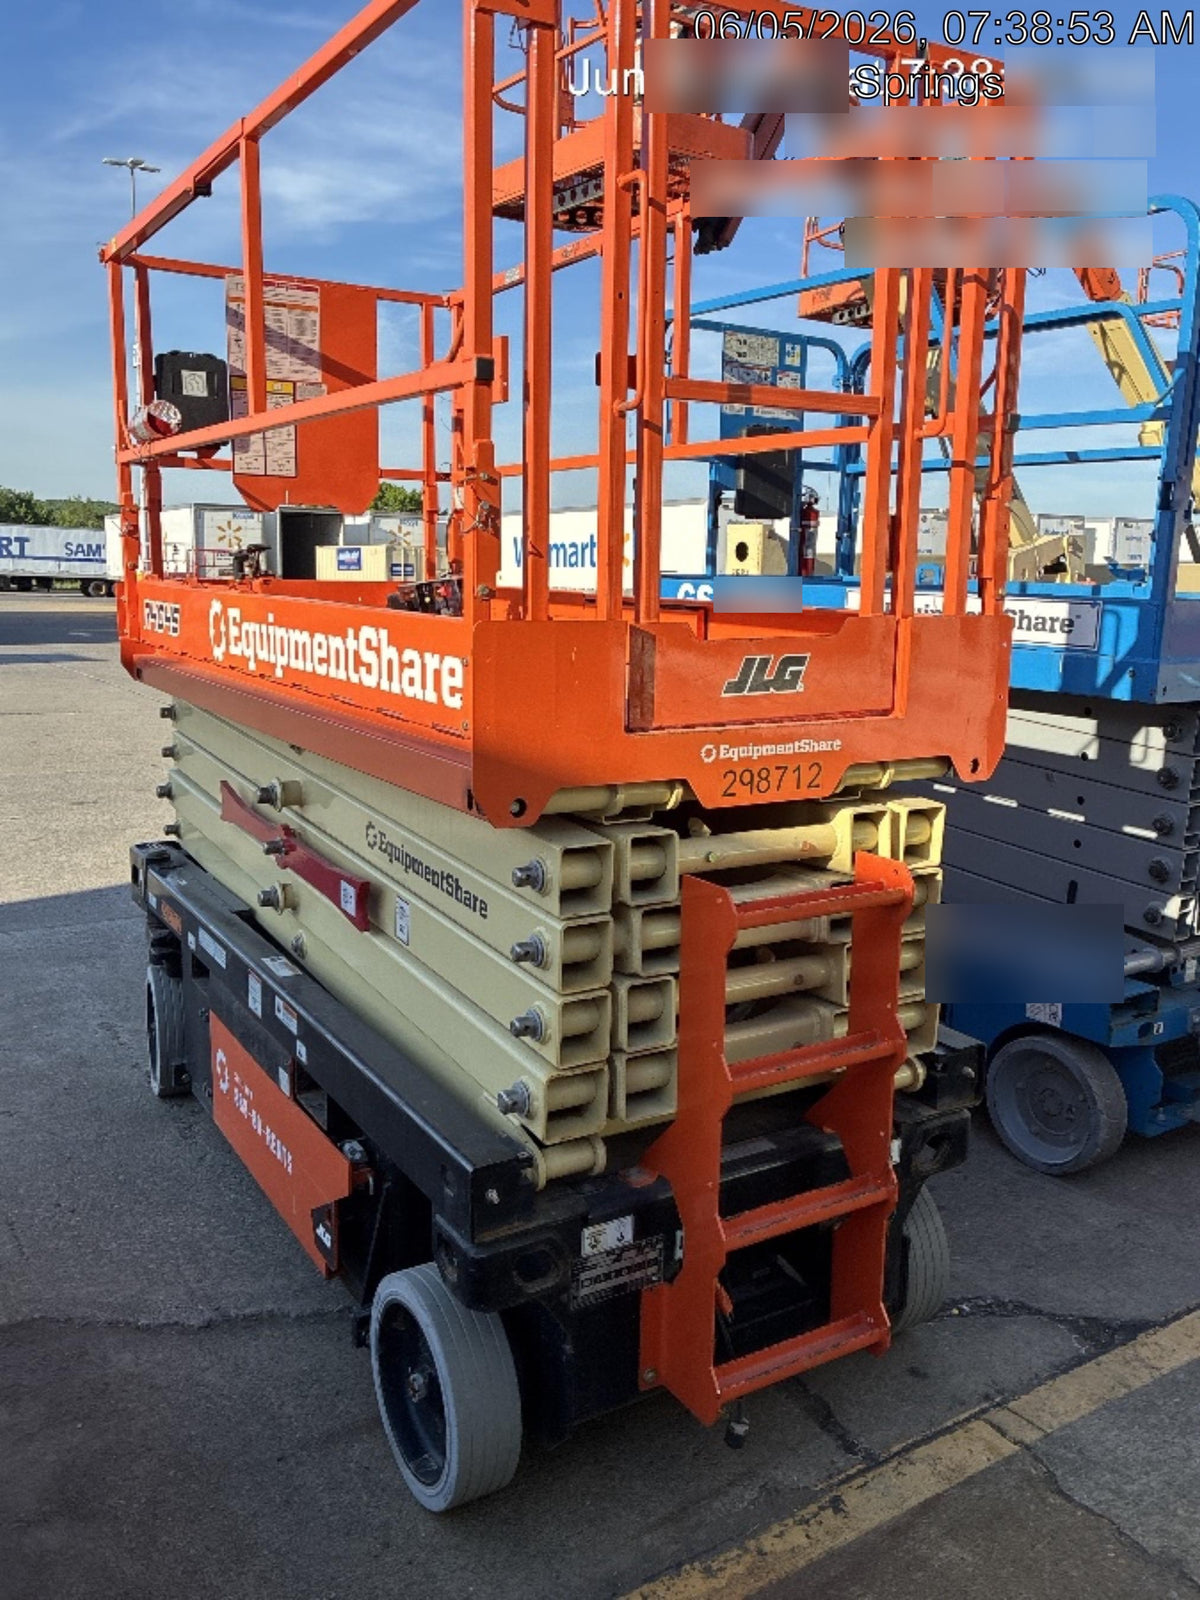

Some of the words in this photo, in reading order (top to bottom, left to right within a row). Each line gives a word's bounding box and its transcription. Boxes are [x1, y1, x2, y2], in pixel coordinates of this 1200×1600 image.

[227, 607, 464, 710] EquipmentShare
[720, 652, 811, 697] JLG
[719, 739, 842, 762] EquipmentShare
[721, 761, 823, 798] 298712
[378, 830, 488, 920] EquipmentShare
